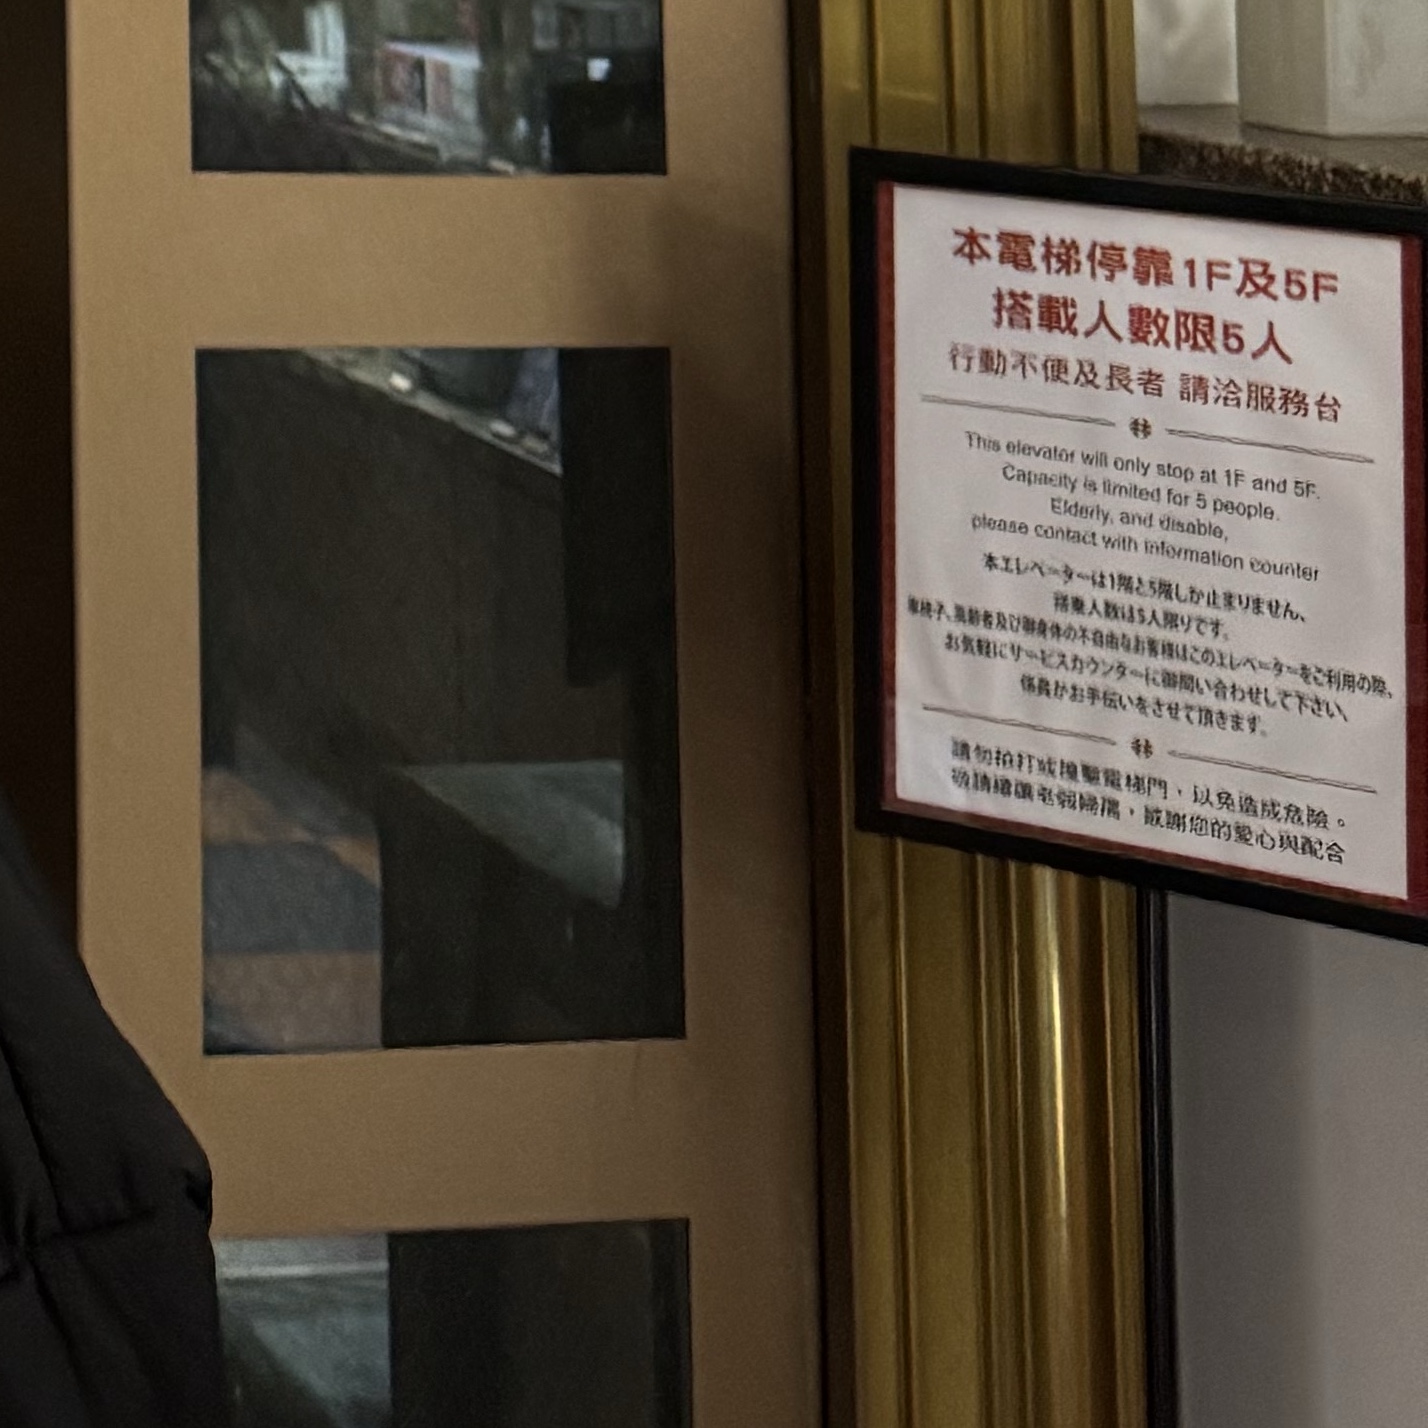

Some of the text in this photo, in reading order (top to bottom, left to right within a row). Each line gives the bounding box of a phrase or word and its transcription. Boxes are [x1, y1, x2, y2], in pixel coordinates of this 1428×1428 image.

[952, 225, 1339, 303] 本電梯停靠1F及5F
[992, 286, 1294, 365] 搭載人數限5人
[948, 341, 1342, 423] 行動不便及長者 請洽服務台
[965, 430, 1321, 501] This elevator will only stop at 1F and 5F.
[1002, 463, 1281, 524] Capacity is limited for 5 people.
[970, 513, 1319, 583] please contact with information counter
[1051, 497, 1229, 542] Elderly, and disable,
